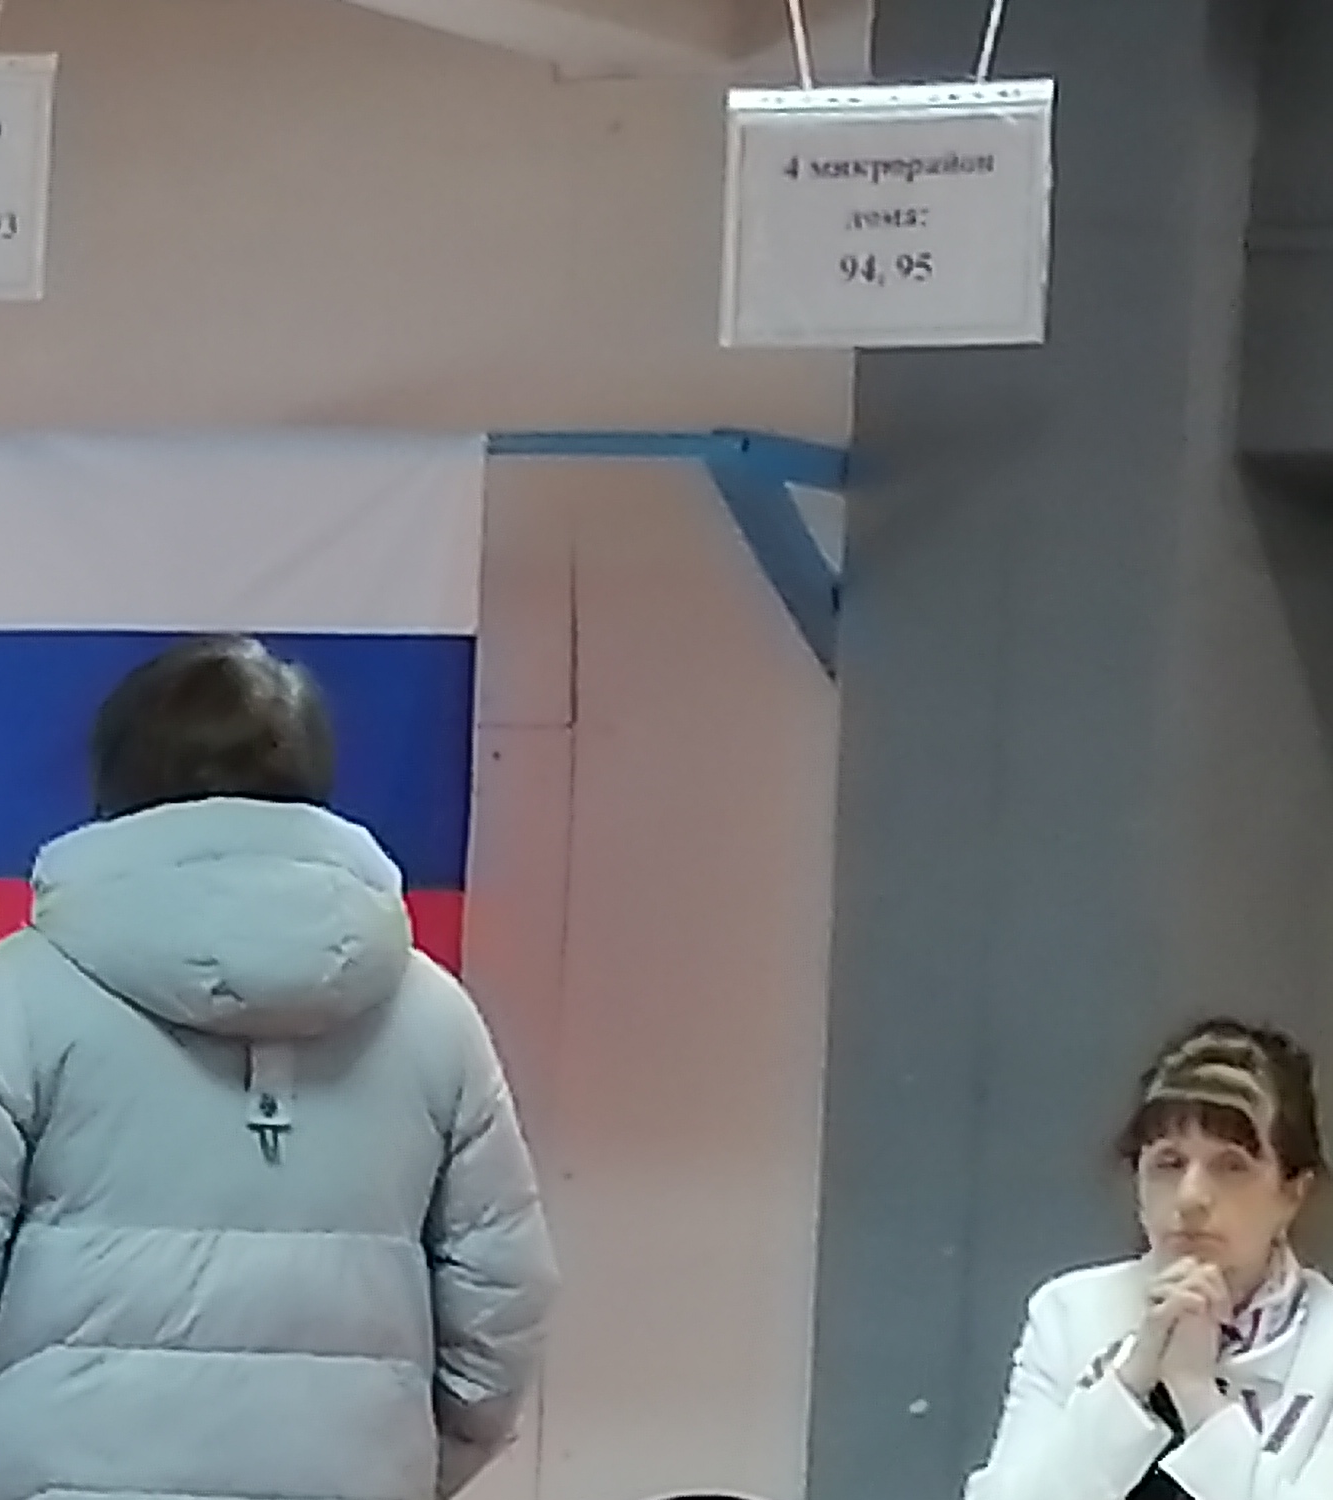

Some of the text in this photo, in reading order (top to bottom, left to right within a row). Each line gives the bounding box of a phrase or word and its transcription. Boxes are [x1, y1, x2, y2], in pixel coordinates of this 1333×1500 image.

[783, 152, 995, 184] 4 микрорайон
[839, 251, 933, 287] 94, 95
